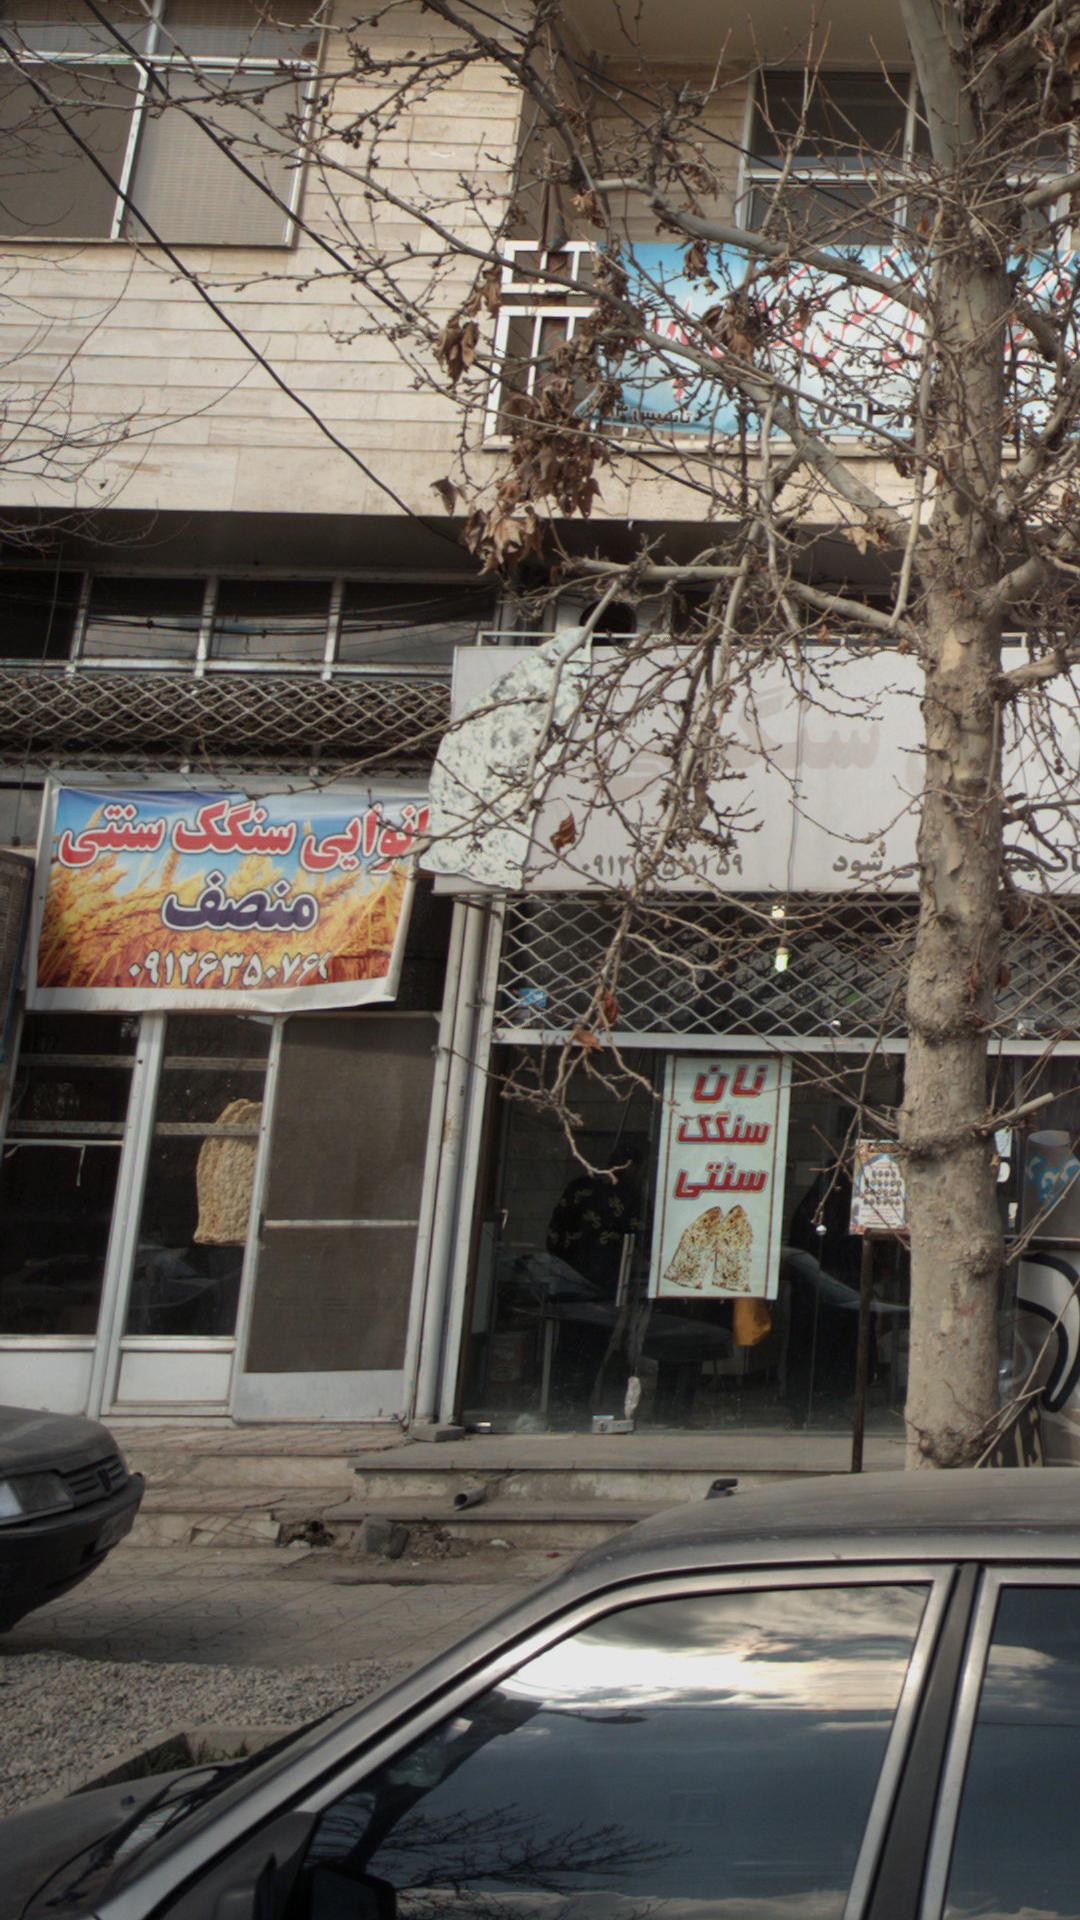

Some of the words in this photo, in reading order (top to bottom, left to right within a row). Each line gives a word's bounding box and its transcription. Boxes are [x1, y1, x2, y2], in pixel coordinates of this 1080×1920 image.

[58, 803, 168, 868] سنتی
[172, 799, 298, 857] سنگک
[301, 802, 431, 874] انوایی
[160, 869, 320, 932] منصف
[691, 1063, 769, 1104] نان
[675, 1110, 772, 1145] سنگک
[673, 1160, 770, 1200] سنتی
